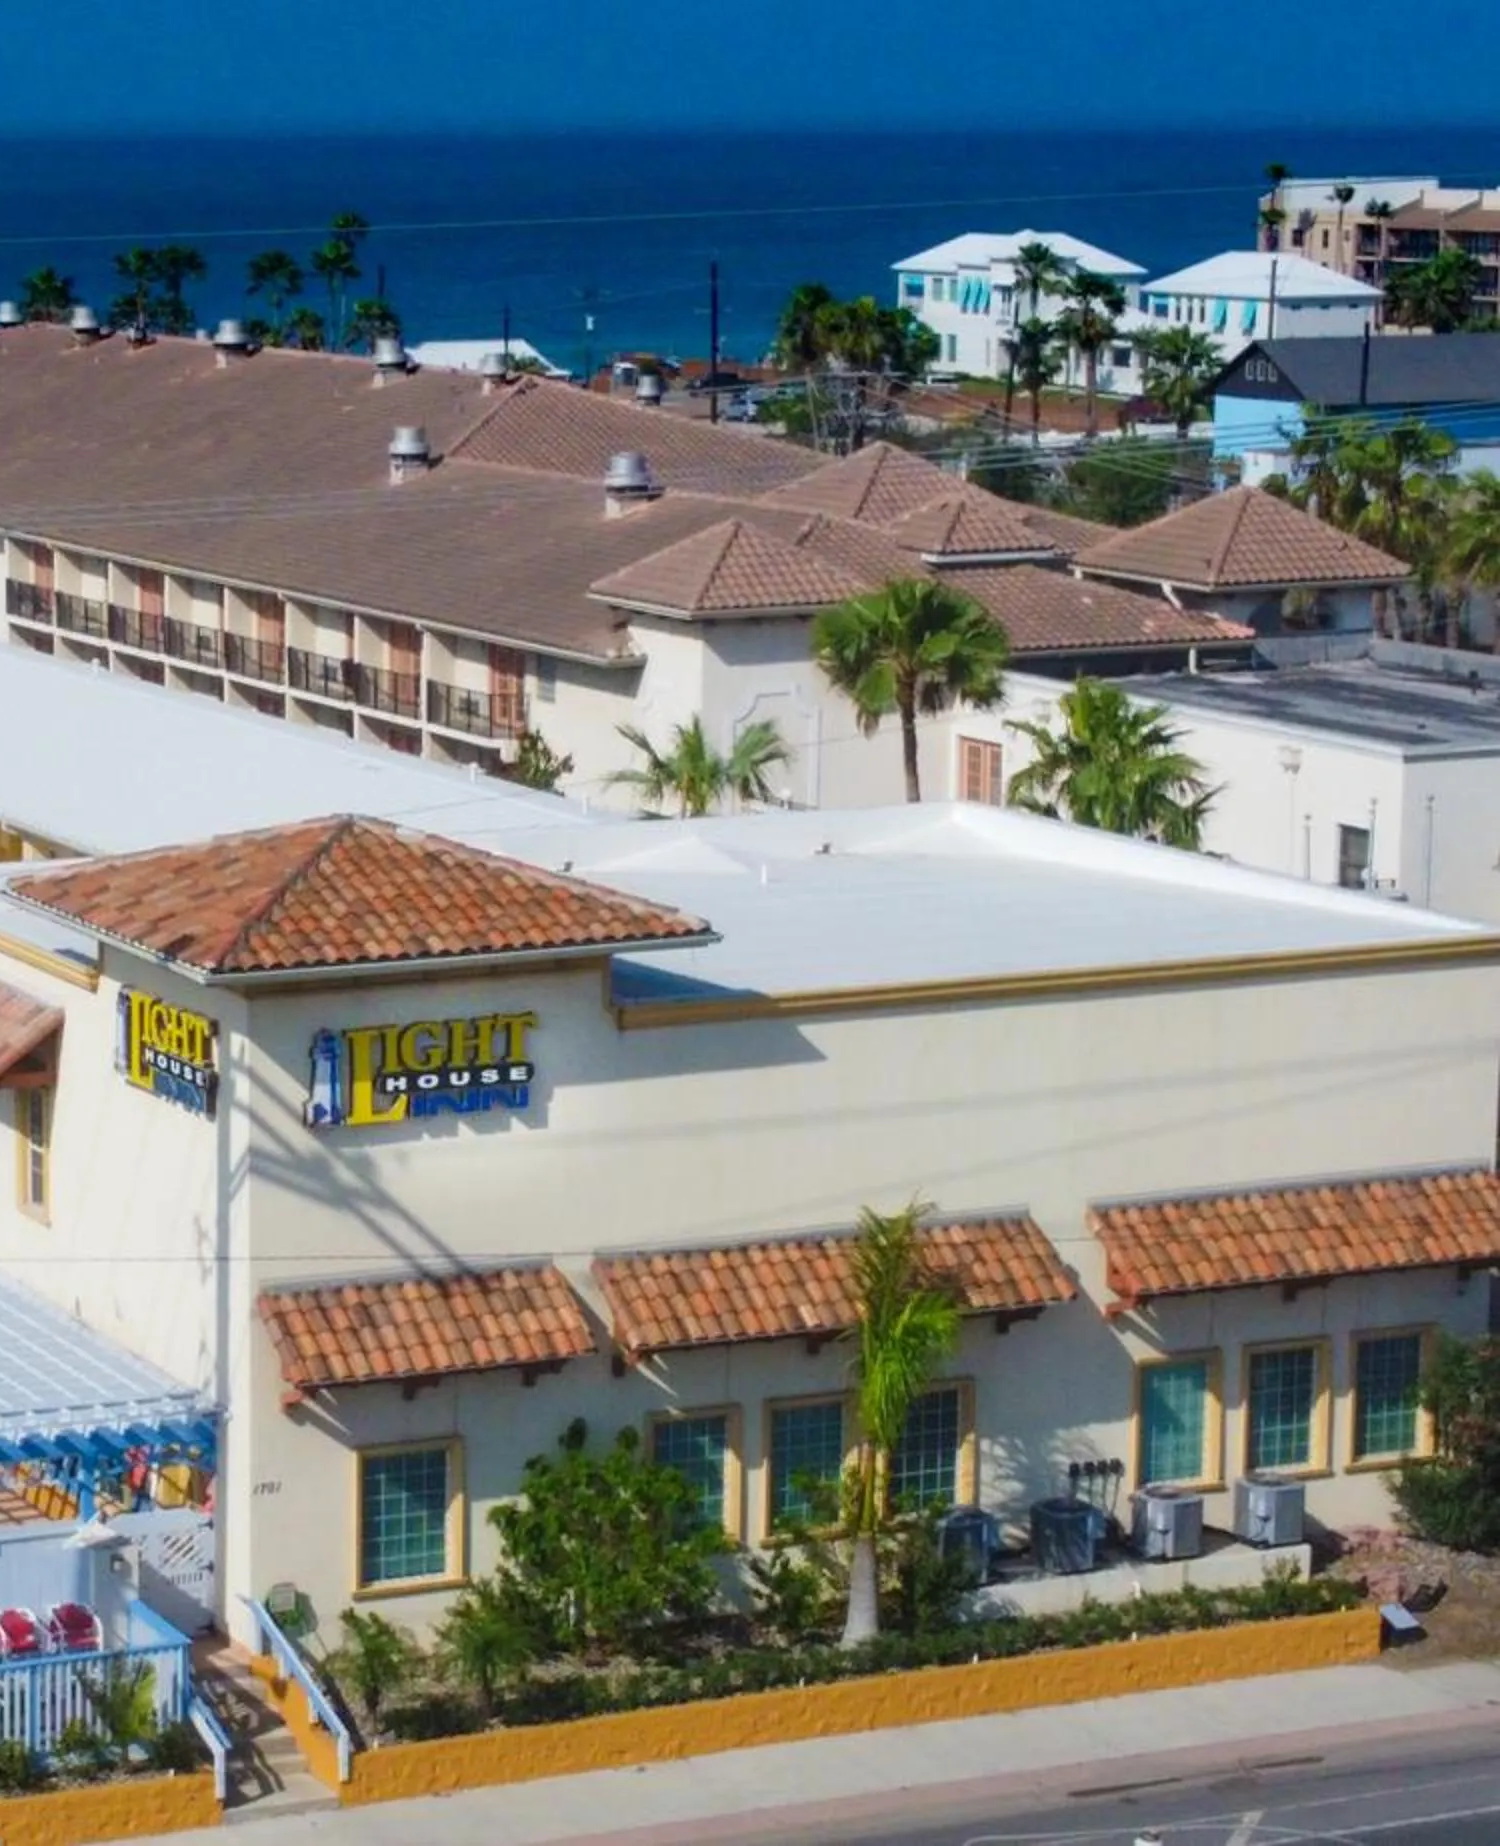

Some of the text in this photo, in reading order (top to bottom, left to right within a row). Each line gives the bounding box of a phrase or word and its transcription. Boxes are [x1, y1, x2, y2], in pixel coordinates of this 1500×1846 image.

[126, 991, 211, 1089] LIGHT
[145, 1047, 208, 1087] HOUSE
[345, 1011, 538, 1126] LIGHT
[386, 1065, 529, 1092] HOUSE
[411, 1086, 529, 1117] INN
